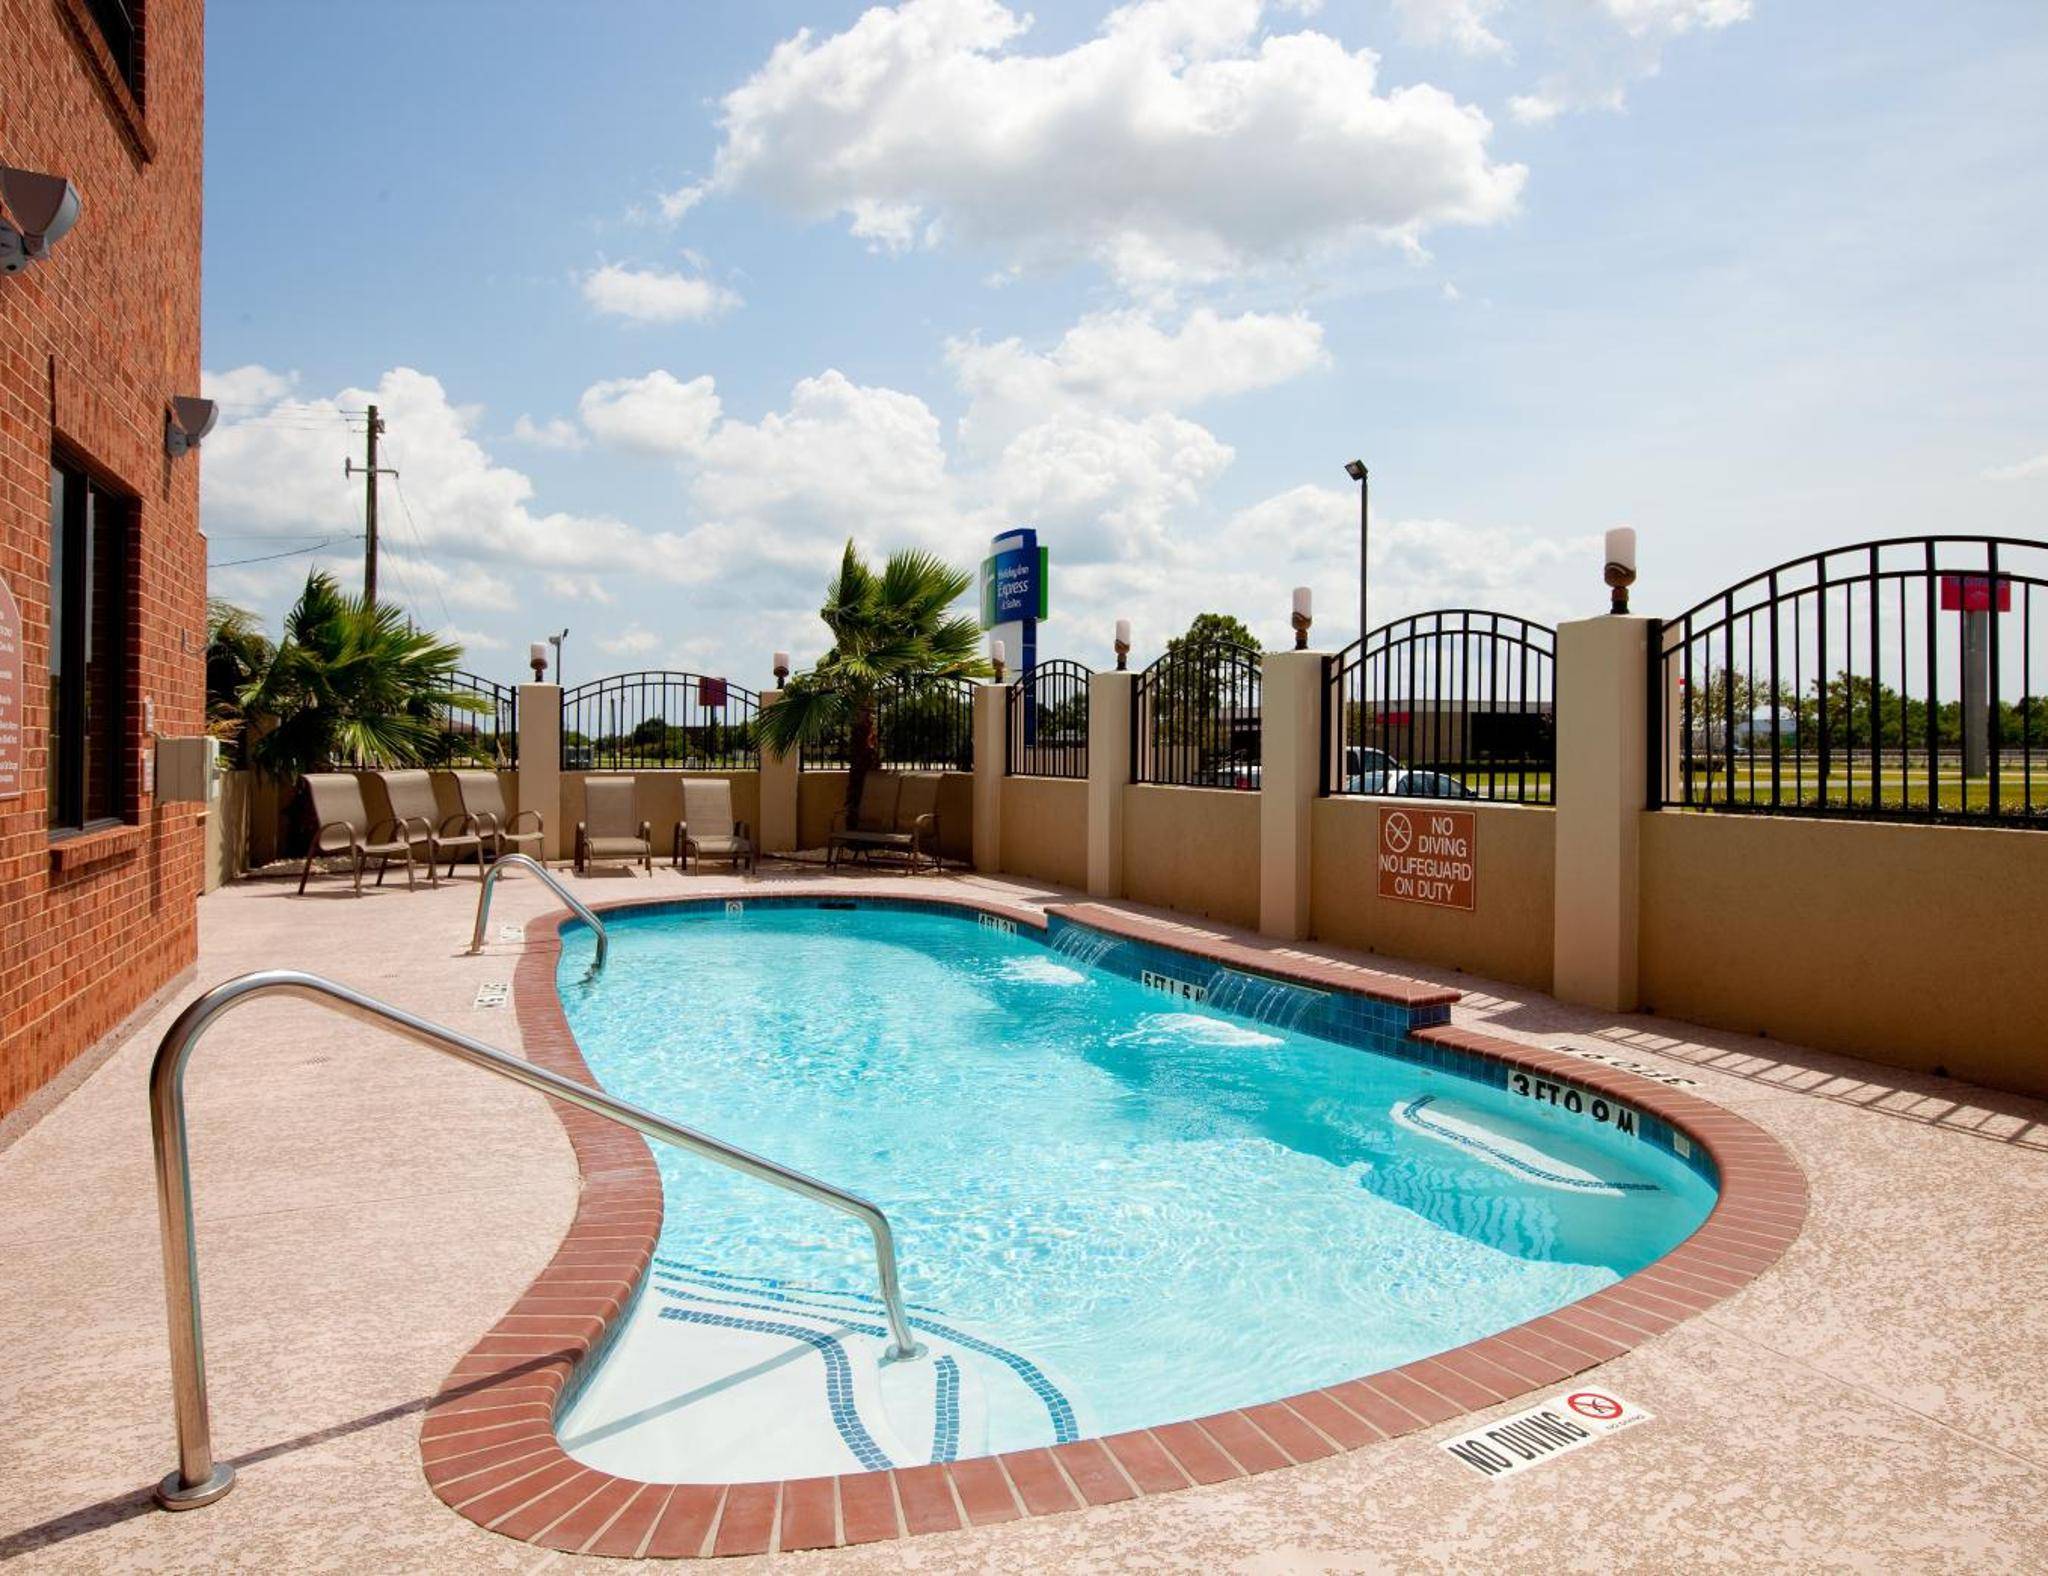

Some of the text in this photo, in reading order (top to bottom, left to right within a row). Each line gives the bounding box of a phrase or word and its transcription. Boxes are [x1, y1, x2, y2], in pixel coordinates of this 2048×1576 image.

[1431, 816, 1454, 836] NO
[1418, 835, 1467, 858] DIVING
[1380, 853, 1472, 882] NO LIFEGUARD
[1394, 876, 1454, 901] ON DUTY
[1447, 1411, 1591, 1476] NO DIVING
